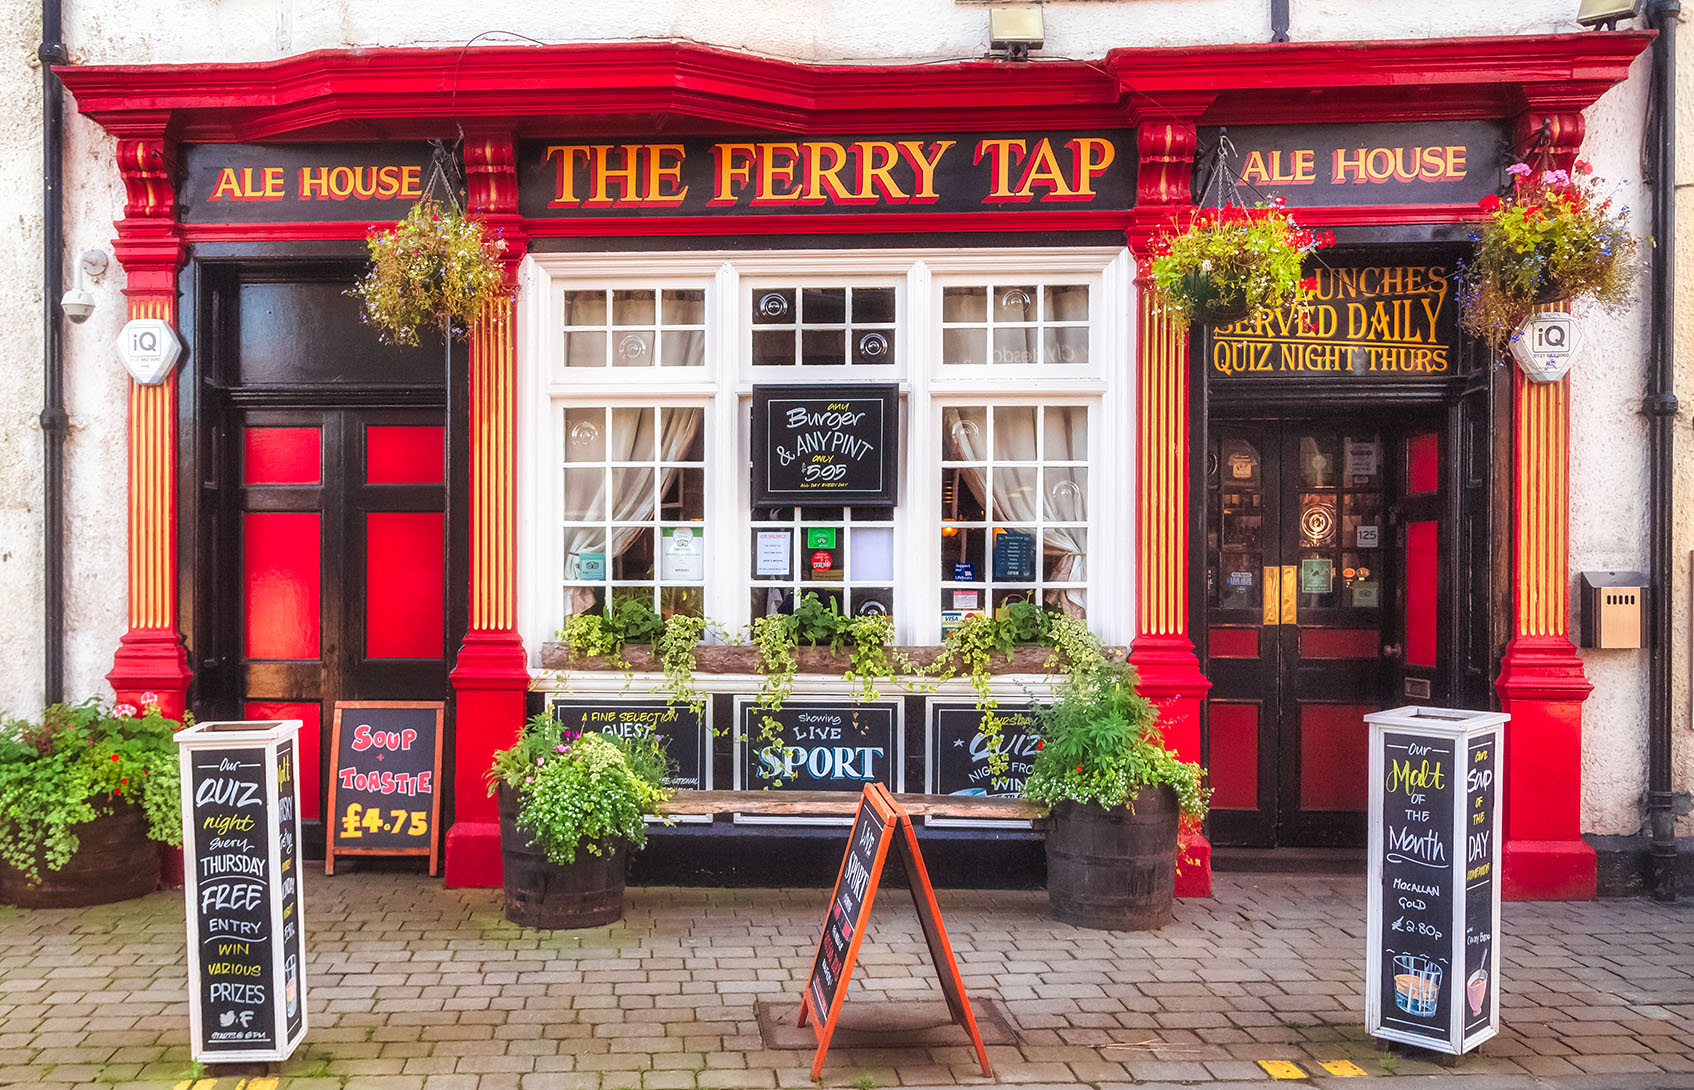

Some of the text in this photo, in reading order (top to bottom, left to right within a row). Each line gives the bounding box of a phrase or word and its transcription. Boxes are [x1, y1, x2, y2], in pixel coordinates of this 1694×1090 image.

[543, 137, 1115, 207] THE FERRY TAP
[1237, 146, 1467, 186] ALE HOUSE
[210, 165, 423, 200] ALE HOUSE
[1347, 290, 1447, 343] DAILY
[133, 331, 157, 352] iQ
[1538, 325, 1565, 348] iQ
[1213, 340, 1448, 376] QUIZ NIGHT THURS
[786, 407, 866, 430] Burger
[776, 431, 874, 466] & ANY PINT
[812, 454, 835, 463] ONLY
[1359, 530, 1376, 540] 125
[581, 712, 679, 723] A FINE SELECTION
[351, 724, 417, 751] SOUP
[602, 723, 651, 739] GUEST
[793, 726, 842, 741] LIVE
[969, 731, 1042, 763] QUIZ
[1408, 743, 1431, 756] Our
[219, 757, 240, 772] Our
[756, 746, 885, 781] SPORT
[1012, 762, 1037, 776] FRO
[339, 766, 431, 797] TOASTIE
[1386, 759, 1445, 796] Malt
[195, 778, 263, 808] QUIZ
[1410, 793, 1426, 805] OF
[1475, 796, 1483, 808] OF
[203, 813, 255, 836] night
[340, 802, 428, 838] £4.75
[1405, 809, 1430, 822] THE
[1472, 811, 1485, 826] THE
[1389, 825, 1446, 861] Month
[1468, 830, 1489, 863] DAY
[200, 854, 266, 877] THURSDAY
[844, 850, 870, 903] SPORT
[201, 884, 263, 914] FREE
[209, 918, 262, 934] ENTRY
[218, 943, 250, 956] WIN
[208, 962, 262, 977] VARIOUS
[210, 982, 265, 1005] PRIZES
